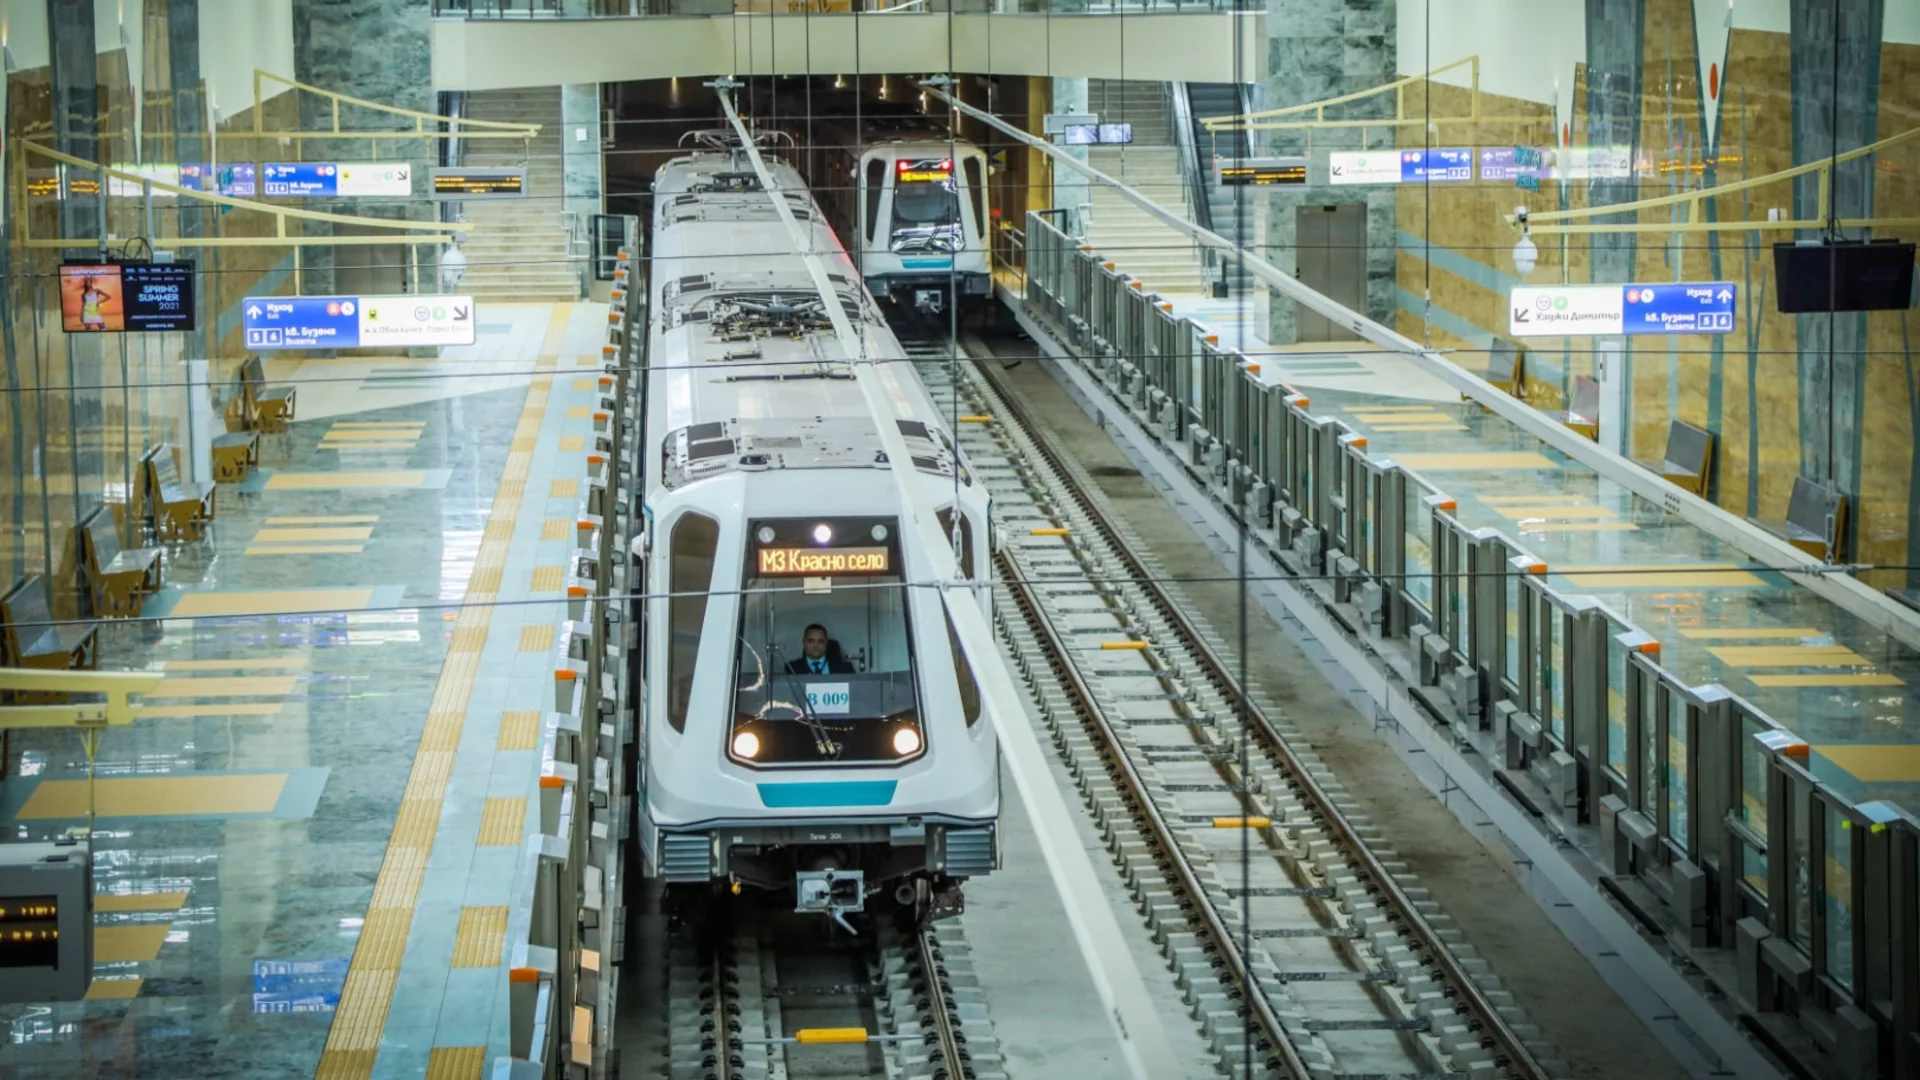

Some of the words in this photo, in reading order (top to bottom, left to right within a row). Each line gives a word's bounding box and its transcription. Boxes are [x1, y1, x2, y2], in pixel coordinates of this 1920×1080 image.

[143, 285, 179, 294] SPRING
[138, 293, 180, 302] SUMMER
[159, 302, 180, 310] 2021
[789, 549, 845, 571] Красно
[849, 553, 884, 569] село
[822, 692, 849, 705] 009
